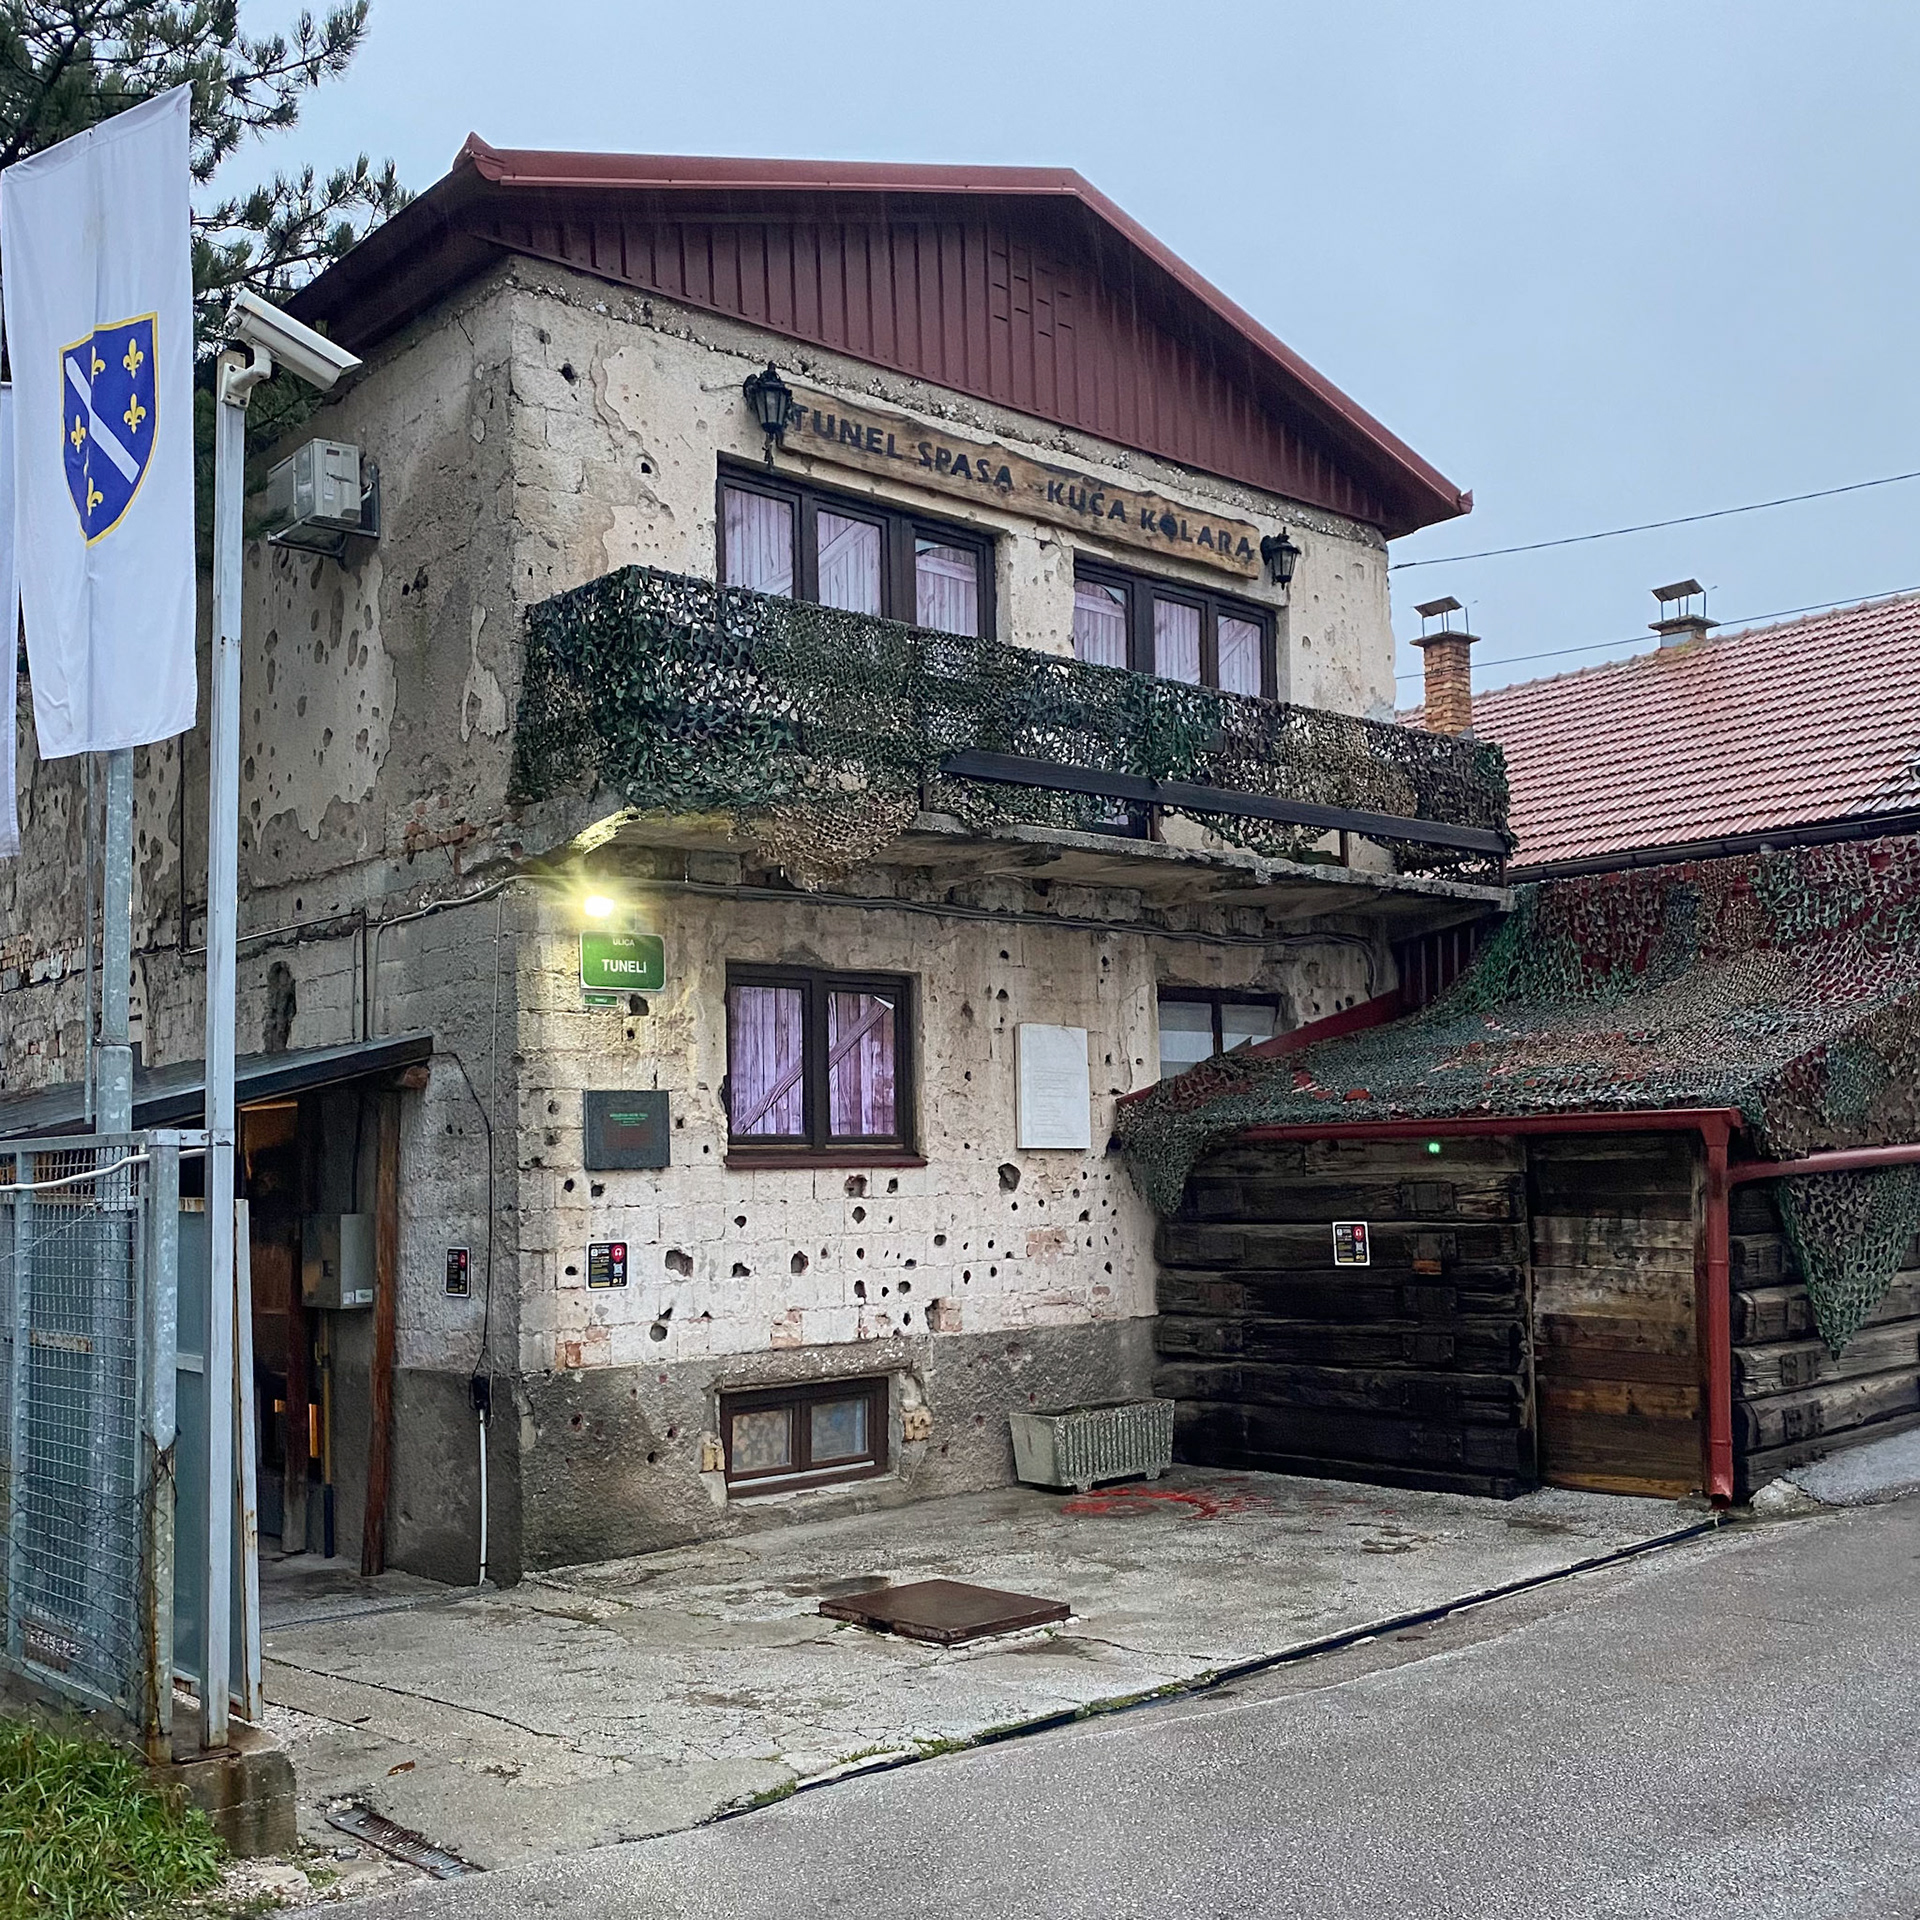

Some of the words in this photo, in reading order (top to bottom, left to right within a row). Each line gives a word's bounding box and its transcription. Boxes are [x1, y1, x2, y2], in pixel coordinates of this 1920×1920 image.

[788, 402, 903, 460] TUNEL
[916, 441, 1014, 491] SPASA
[1140, 507, 1256, 563] KOLARA
[612, 938, 635, 947] ULICA
[600, 958, 647, 974] TUNELI
